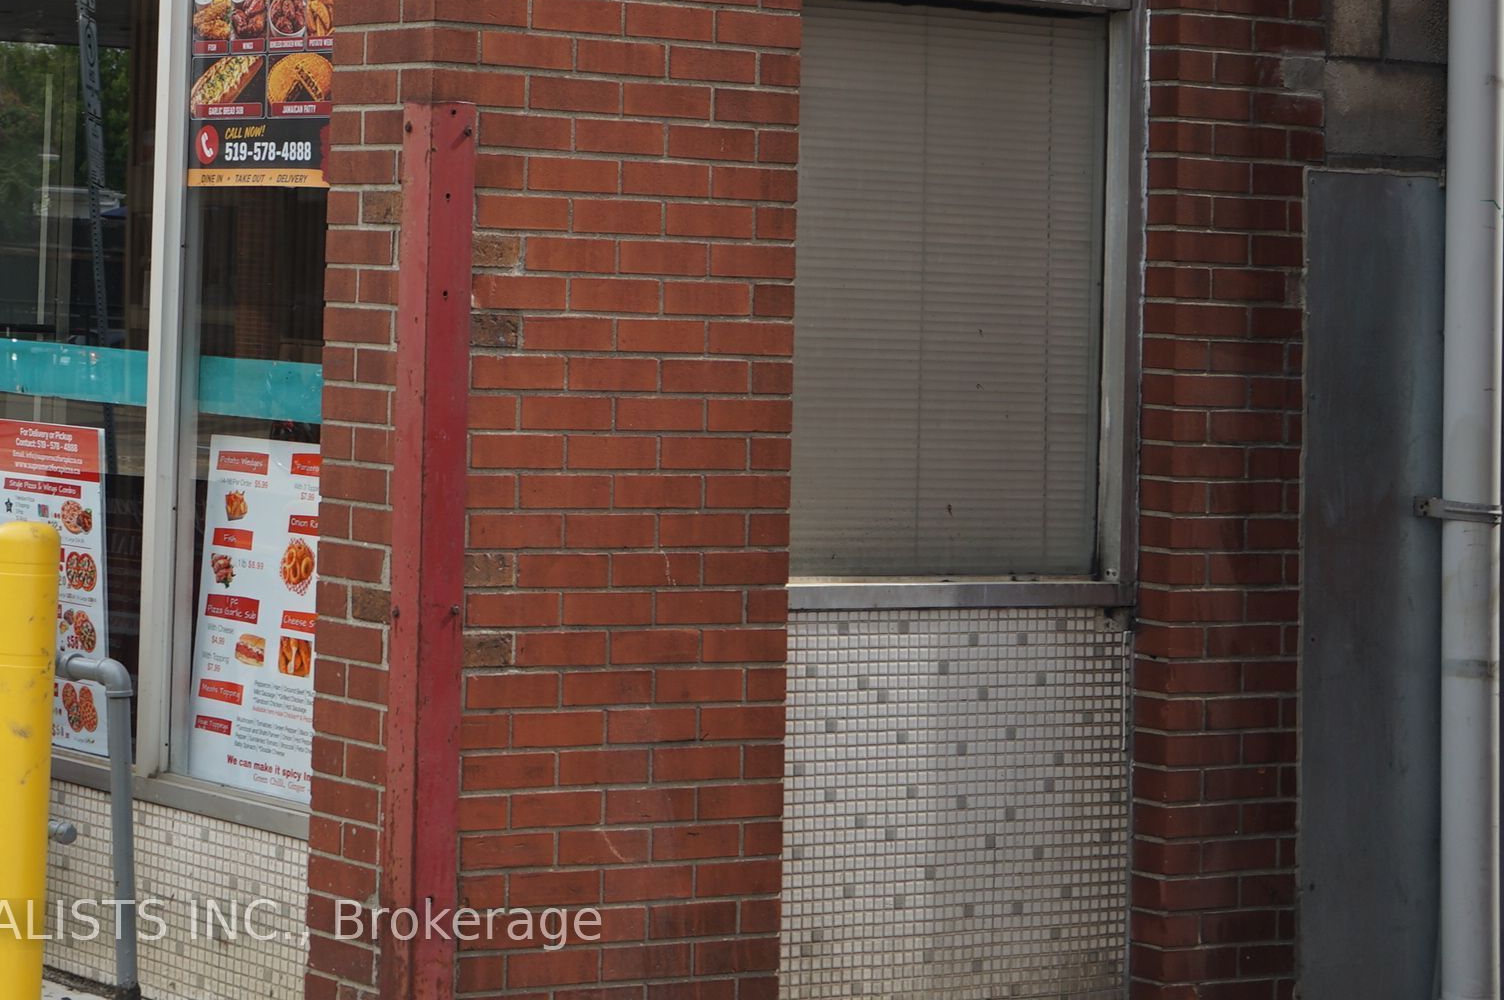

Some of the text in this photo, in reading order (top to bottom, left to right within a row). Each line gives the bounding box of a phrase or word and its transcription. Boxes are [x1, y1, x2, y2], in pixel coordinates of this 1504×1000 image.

[225, 124, 266, 140] CALL NOW!
[224, 141, 311, 161] 519-578-4888
[235, 174, 251, 183] TAKE
[251, 174, 266, 183] OUT
[276, 174, 308, 183] DELIVERY
[220, 455, 263, 471] Potato Wedges
[290, 518, 308, 527] Onion
[223, 533, 237, 543] Fish
[208, 604, 256, 620] Pizza Garlic Sub
[283, 614, 307, 627] Cheese
[227, 754, 302, 781] We can make it spicy
